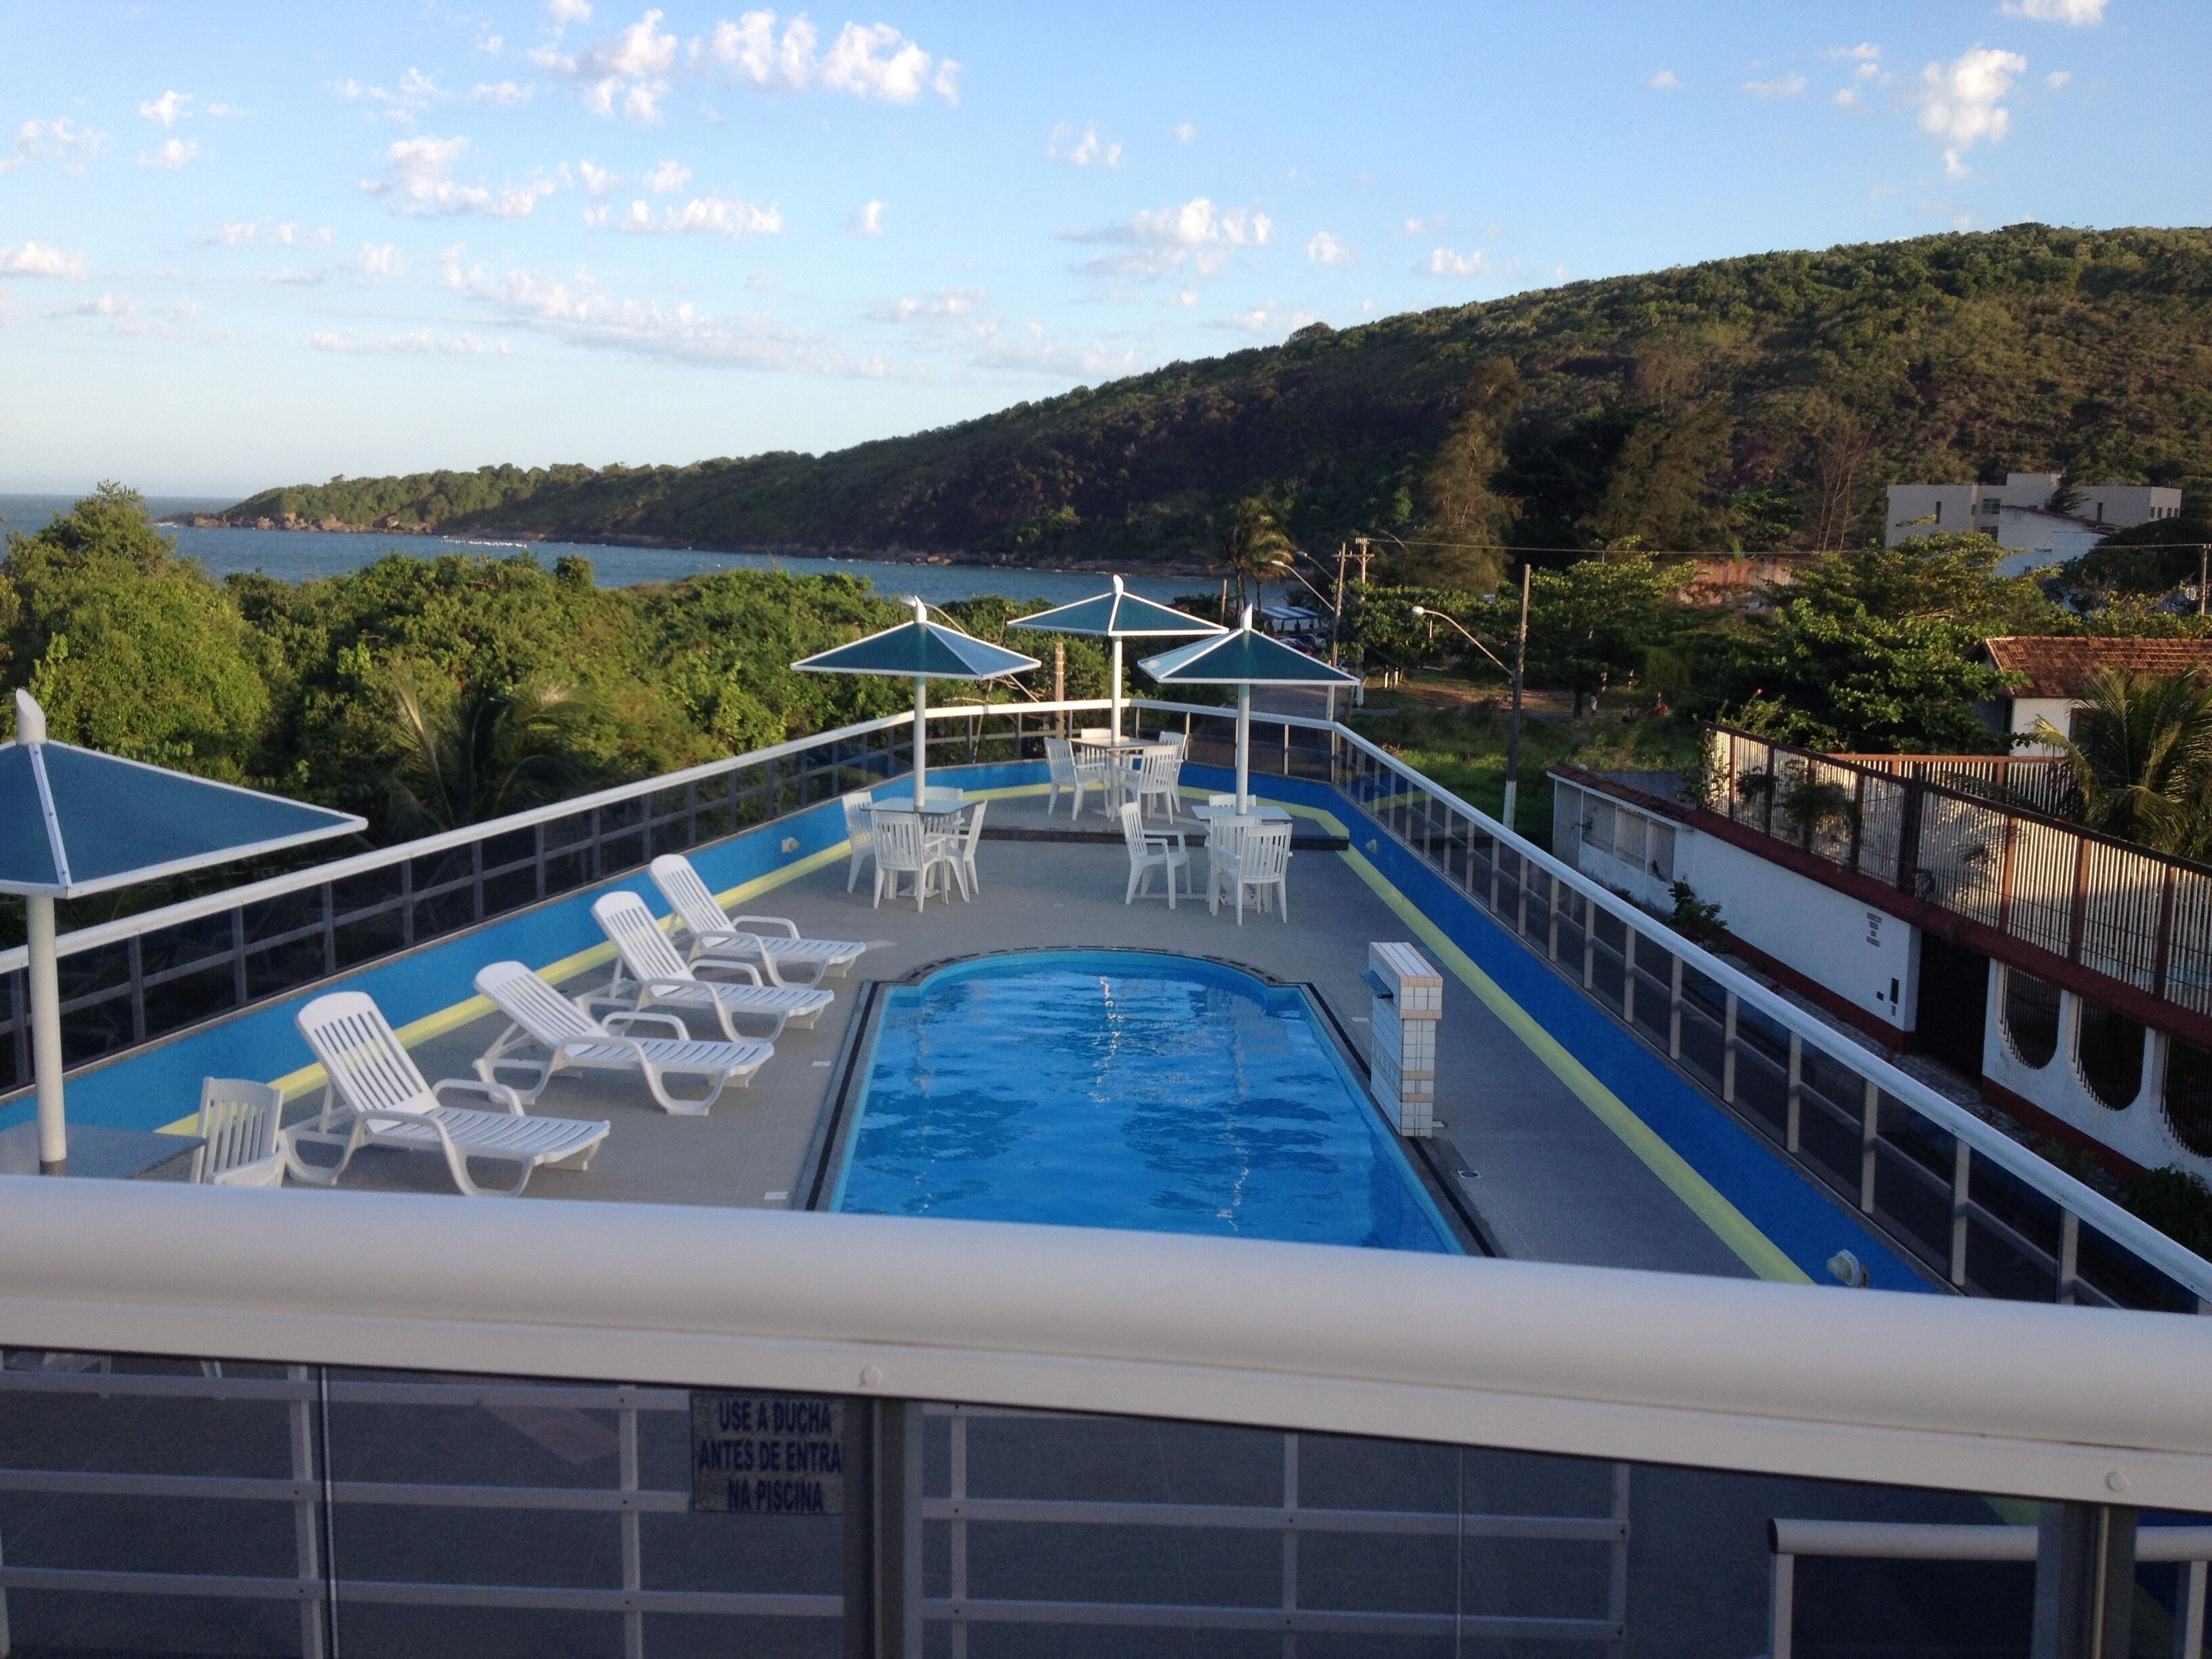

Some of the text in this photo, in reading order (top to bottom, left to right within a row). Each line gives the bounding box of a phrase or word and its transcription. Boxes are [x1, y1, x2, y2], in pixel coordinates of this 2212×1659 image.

[719, 1401, 832, 1433] USE A DUCHA
[699, 1439, 842, 1473] ANTES DE ENTRA
[728, 1479, 823, 1511] NA PISCINA
